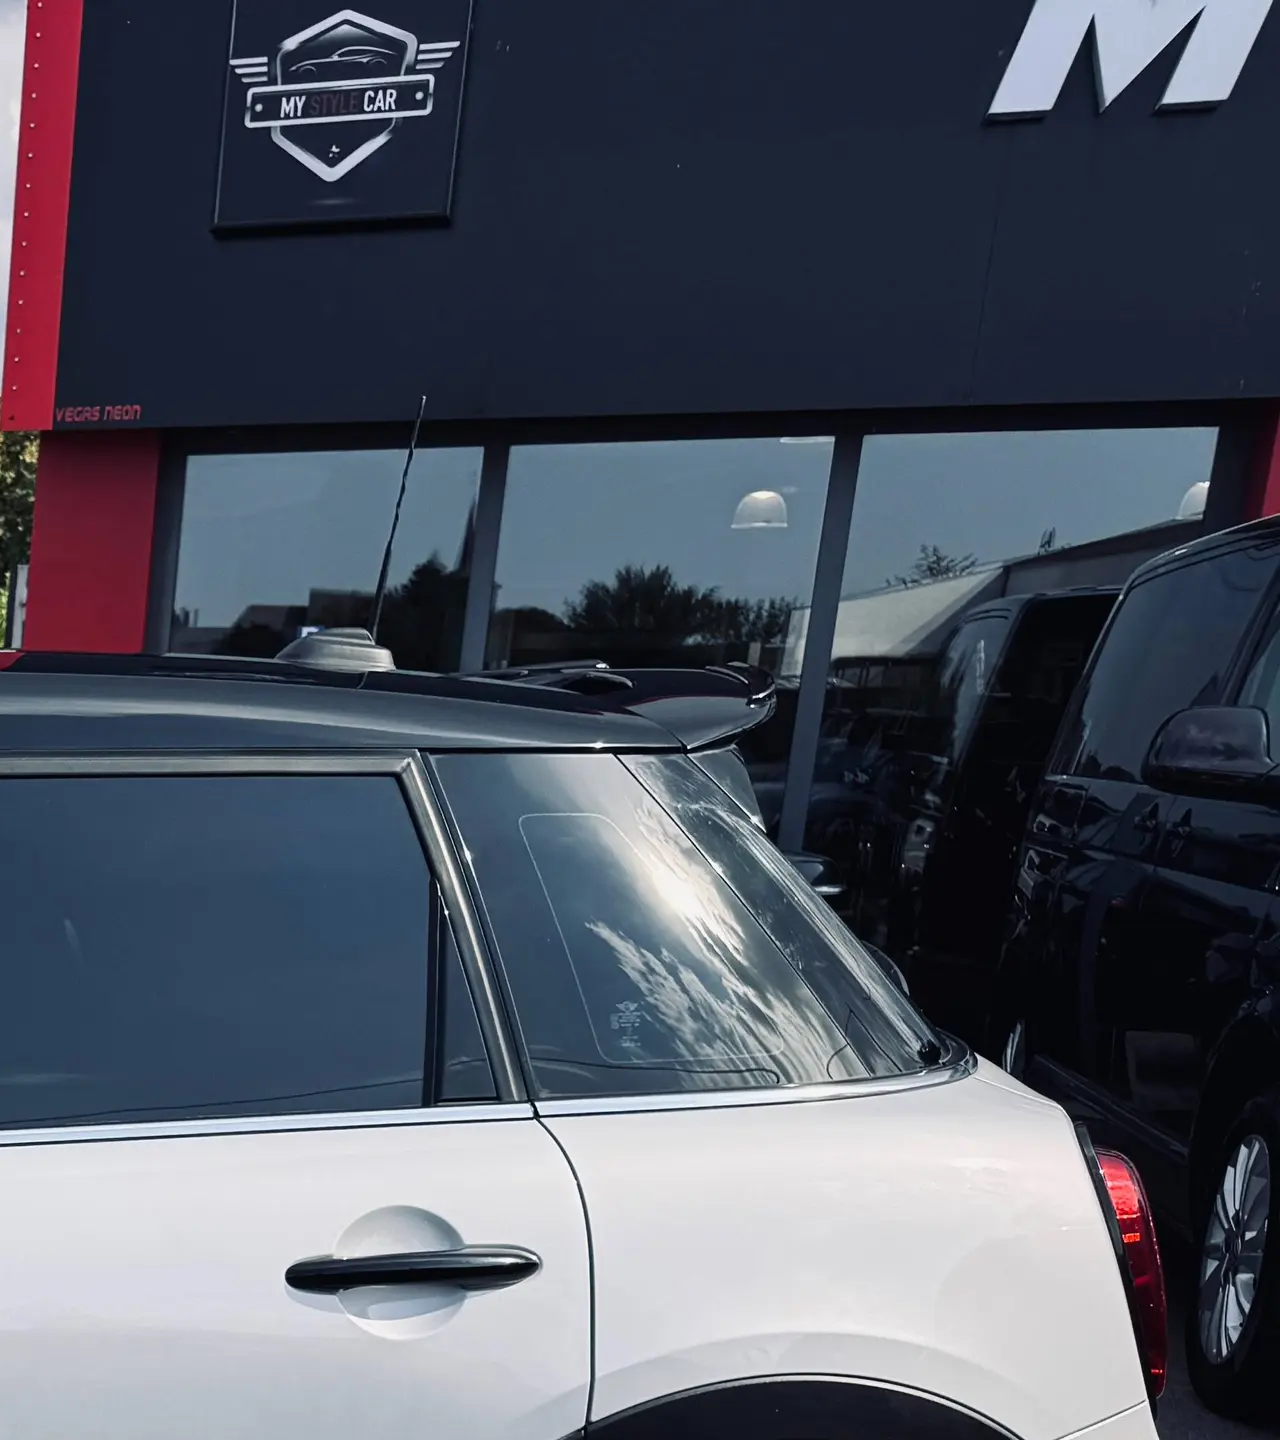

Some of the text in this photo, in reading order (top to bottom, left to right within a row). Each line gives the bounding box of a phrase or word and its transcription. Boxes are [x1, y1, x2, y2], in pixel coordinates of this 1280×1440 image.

[986, 0, 1273, 118] M
[280, 88, 397, 118] MY STYLE CAR
[56, 406, 100, 422] VEGAS
